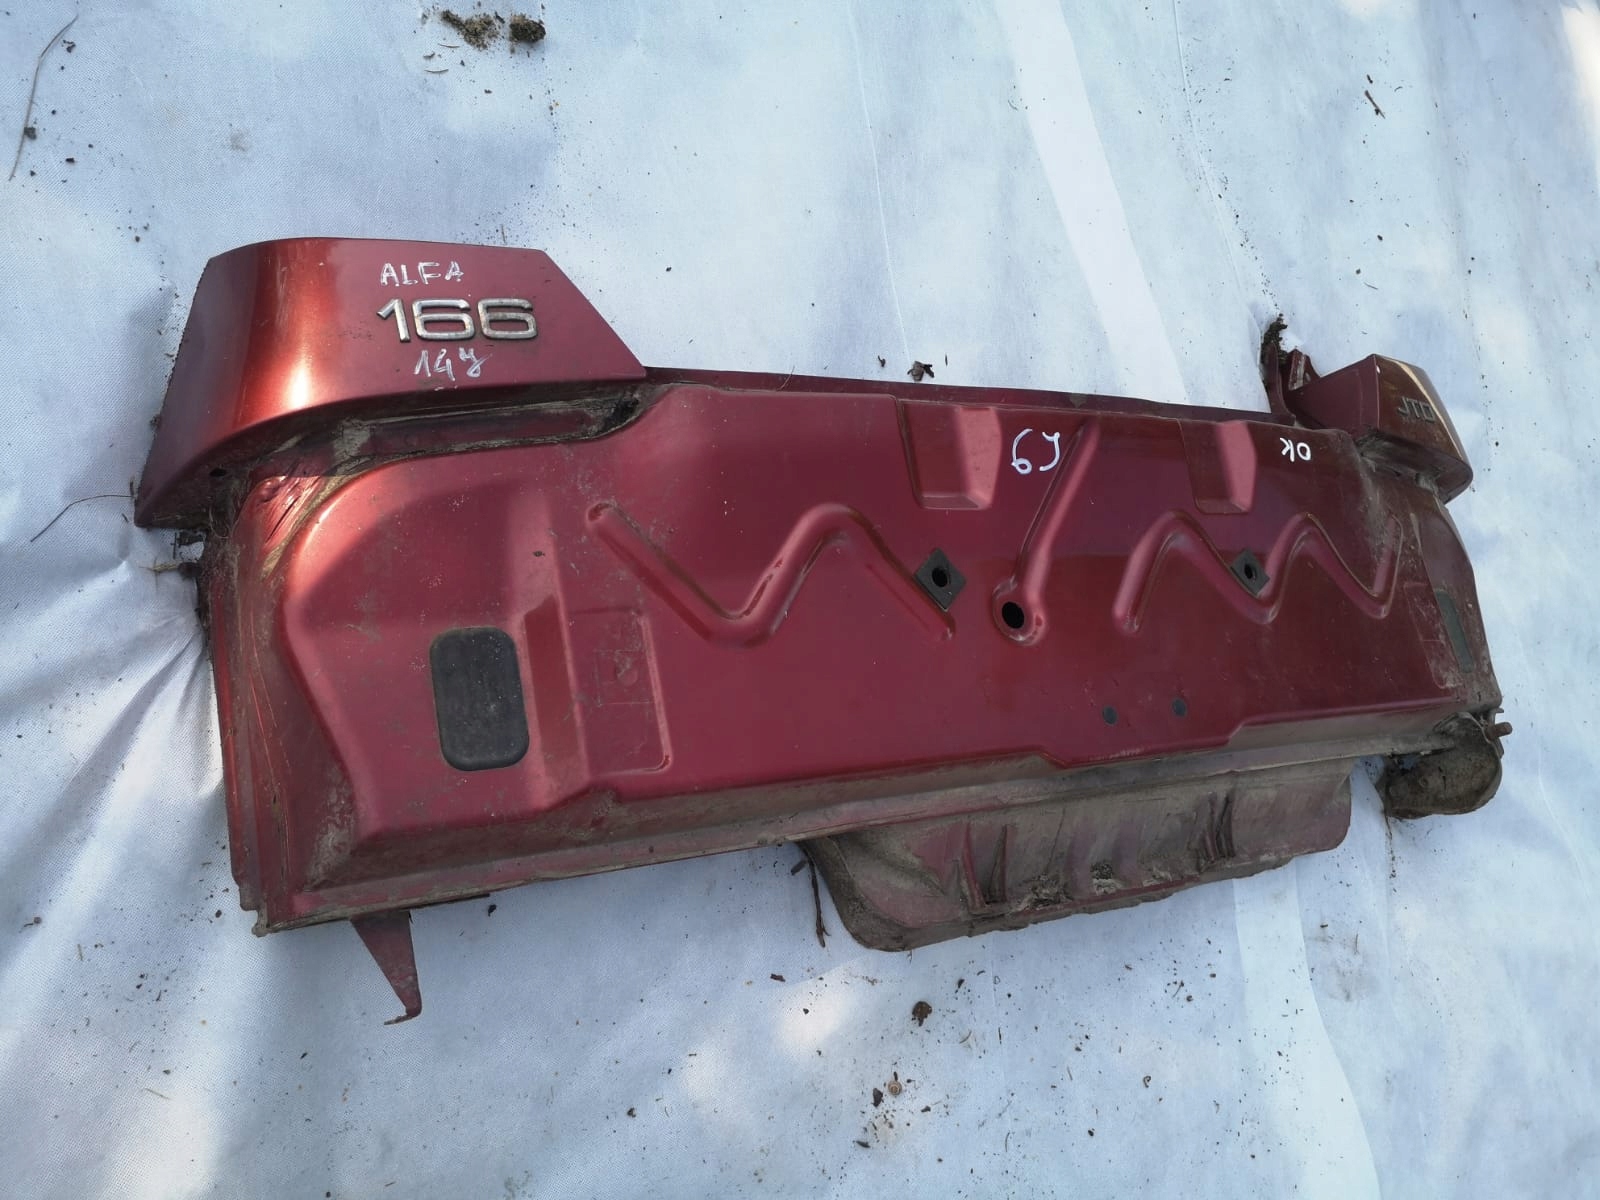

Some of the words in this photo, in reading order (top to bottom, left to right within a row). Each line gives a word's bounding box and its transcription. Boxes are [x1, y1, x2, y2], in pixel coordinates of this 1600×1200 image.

[380, 261, 464, 287] ALFA
[376, 298, 539, 342] 166
[1397, 396, 1436, 423] JTD
[1279, 437, 1311, 462] OK
